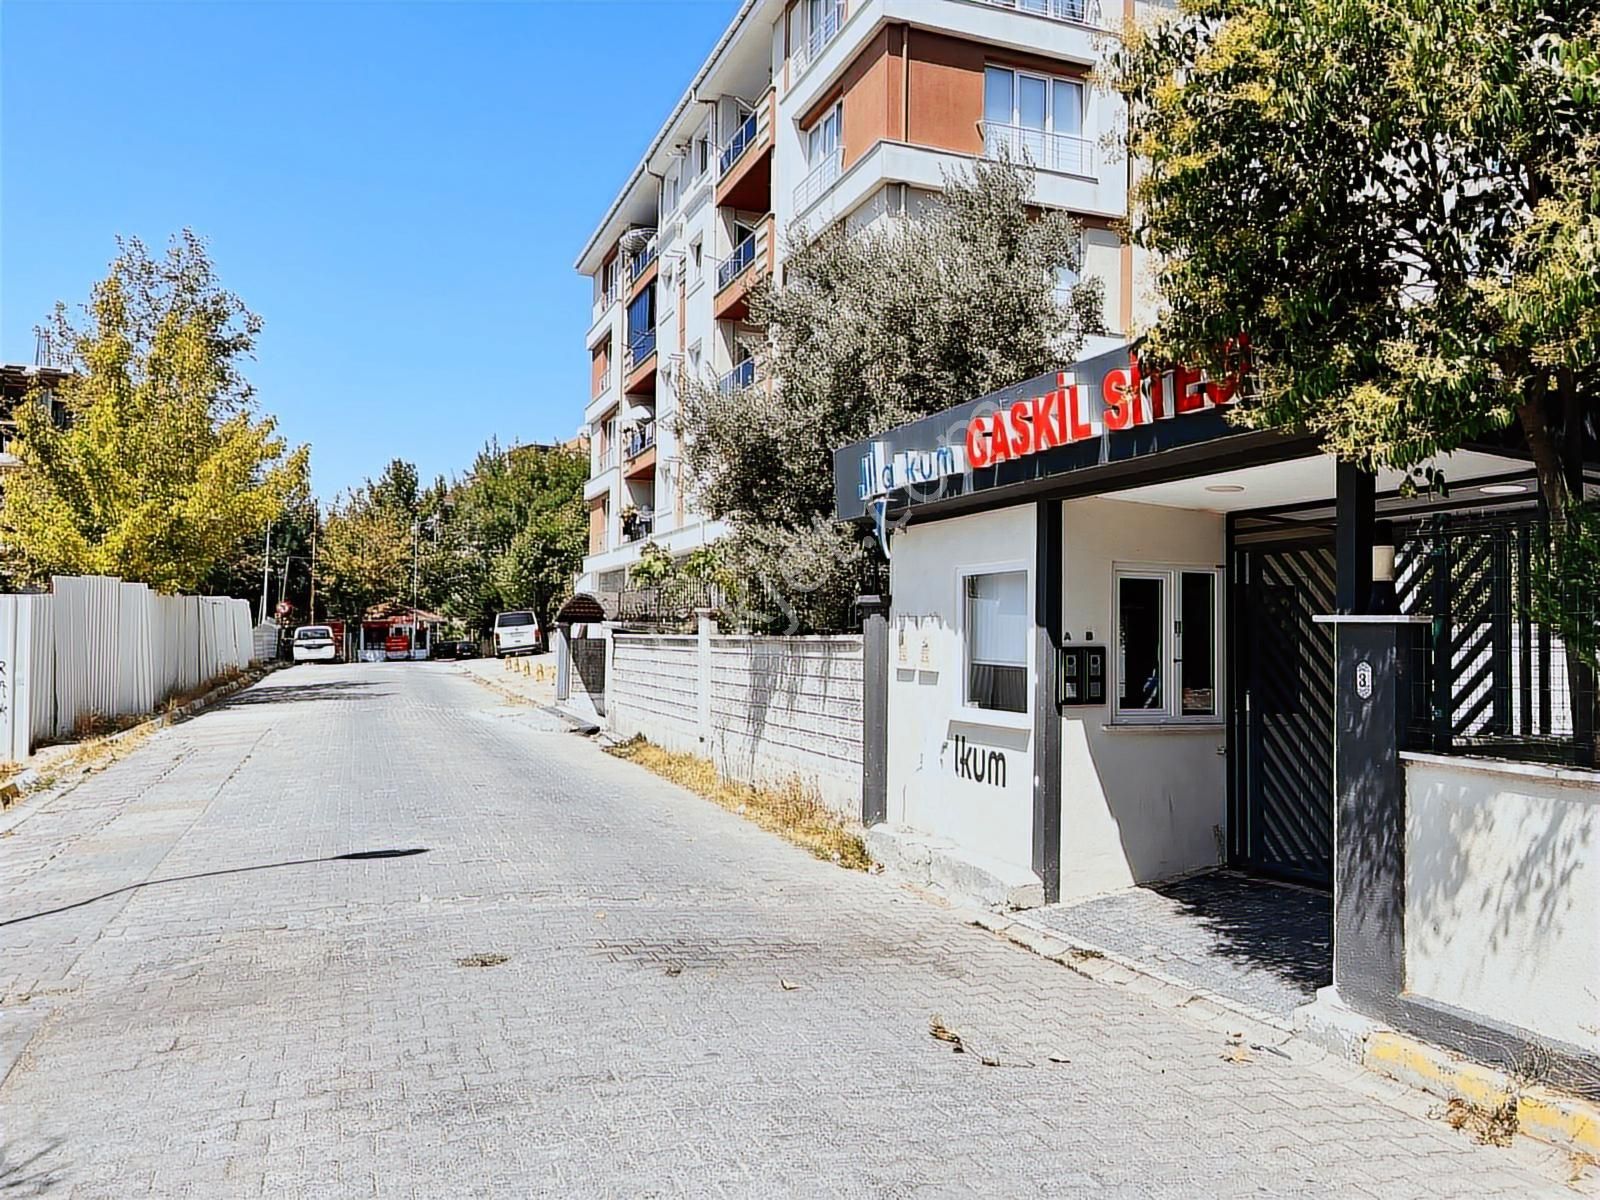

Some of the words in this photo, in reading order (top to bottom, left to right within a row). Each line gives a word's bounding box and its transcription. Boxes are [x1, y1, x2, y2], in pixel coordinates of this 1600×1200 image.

[966, 369, 1093, 468] GASKİL
[1063, 631, 1072, 641] A
[1359, 673, 1367, 687] 3
